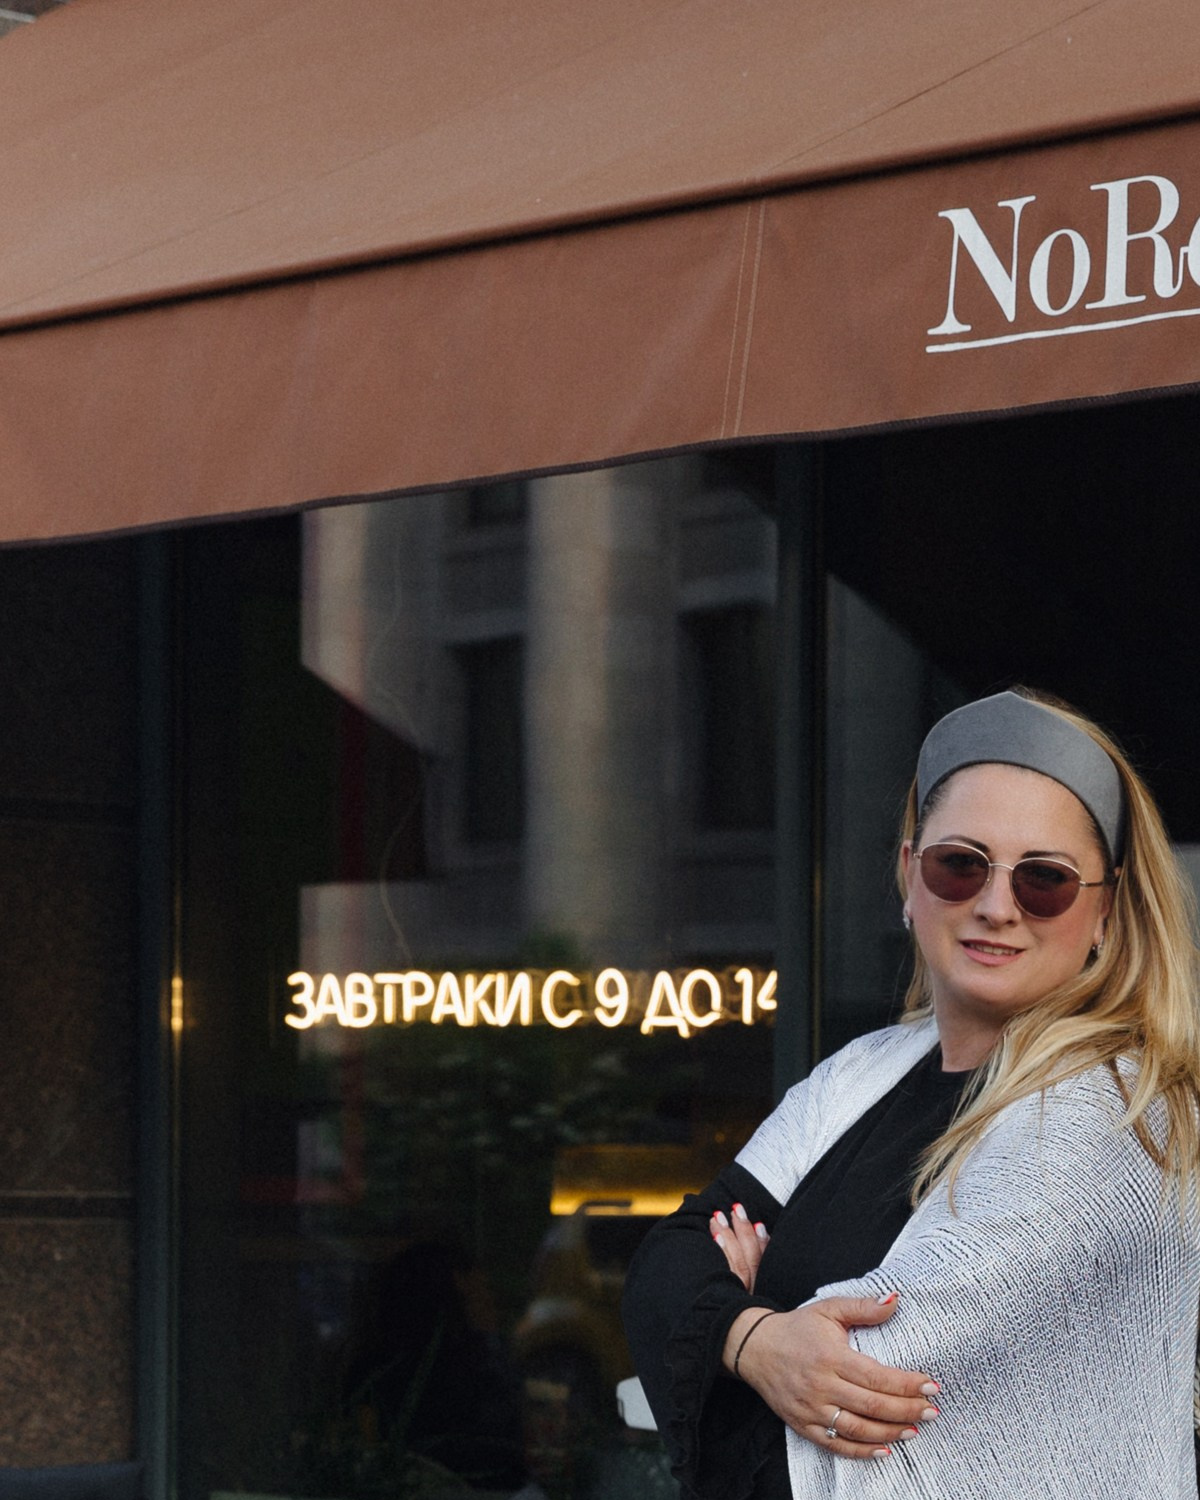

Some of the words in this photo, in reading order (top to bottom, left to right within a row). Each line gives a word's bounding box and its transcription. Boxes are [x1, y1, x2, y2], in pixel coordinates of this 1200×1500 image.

[284, 969, 532, 1029] ЗАВТРАКИ
[594, 967, 629, 1028] 9
[639, 969, 722, 1038] ДО
